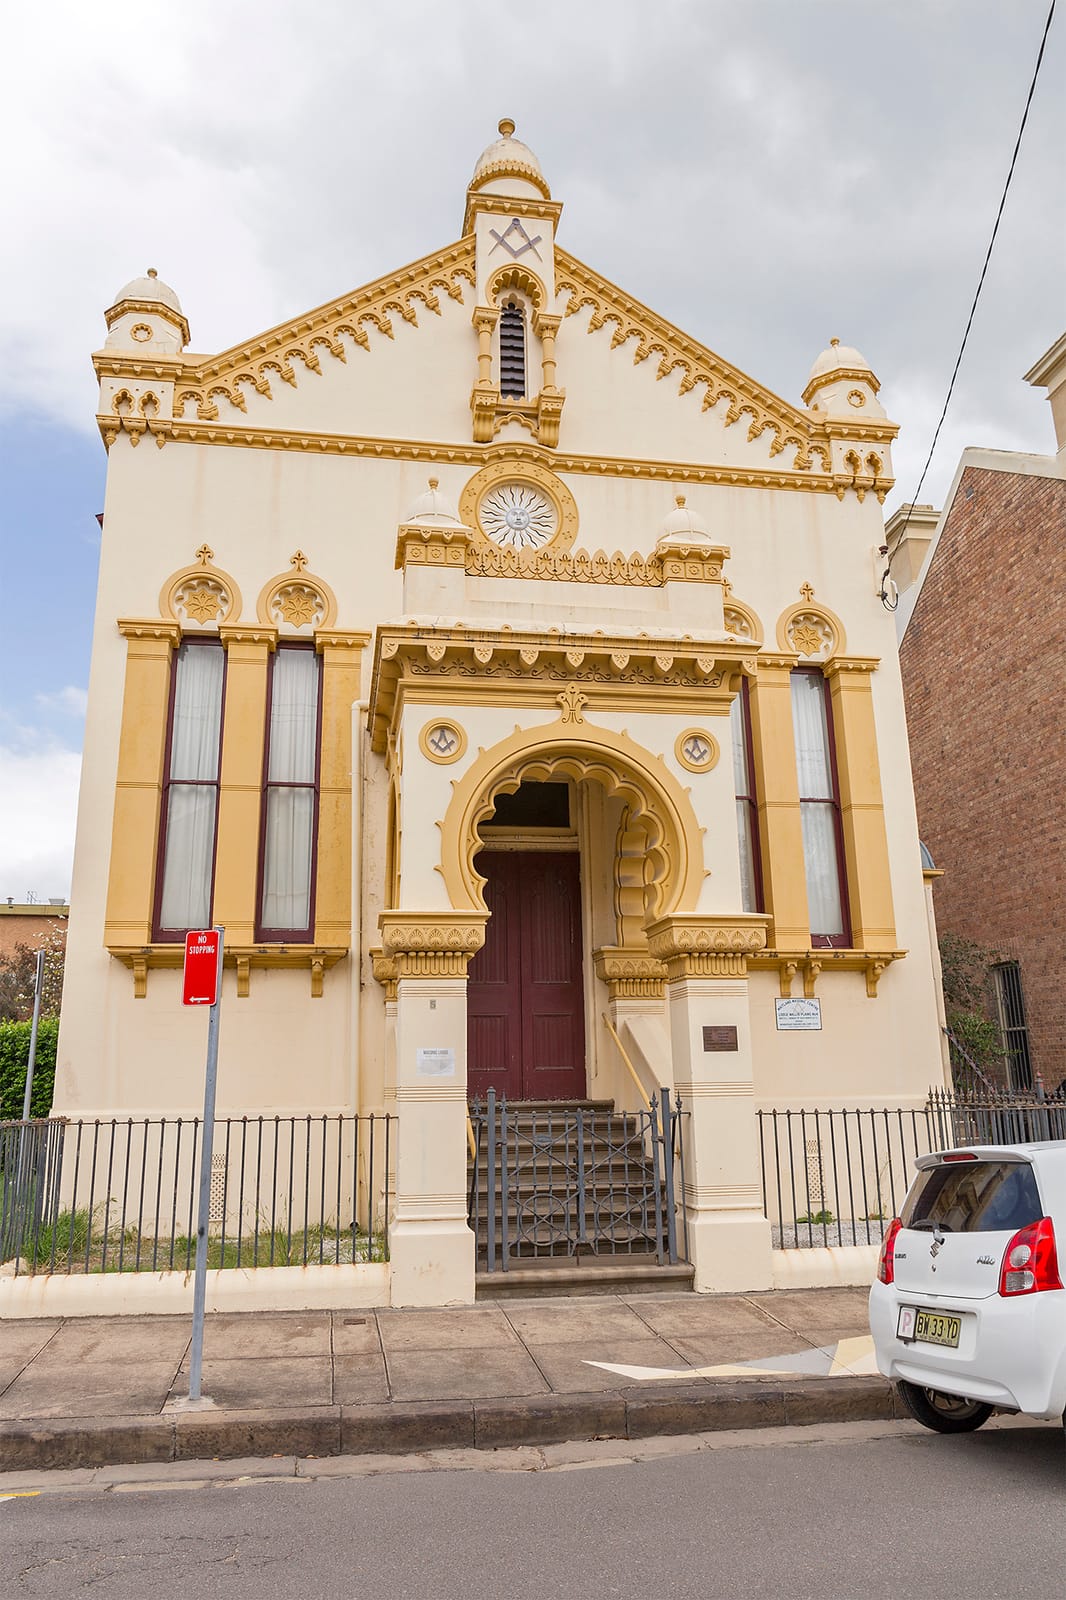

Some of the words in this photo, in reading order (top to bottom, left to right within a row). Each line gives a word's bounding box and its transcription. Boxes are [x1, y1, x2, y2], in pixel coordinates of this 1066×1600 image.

[198, 935, 207, 944] NO
[189, 945, 215, 954] STOPPING
[903, 1312, 912, 1333] P
